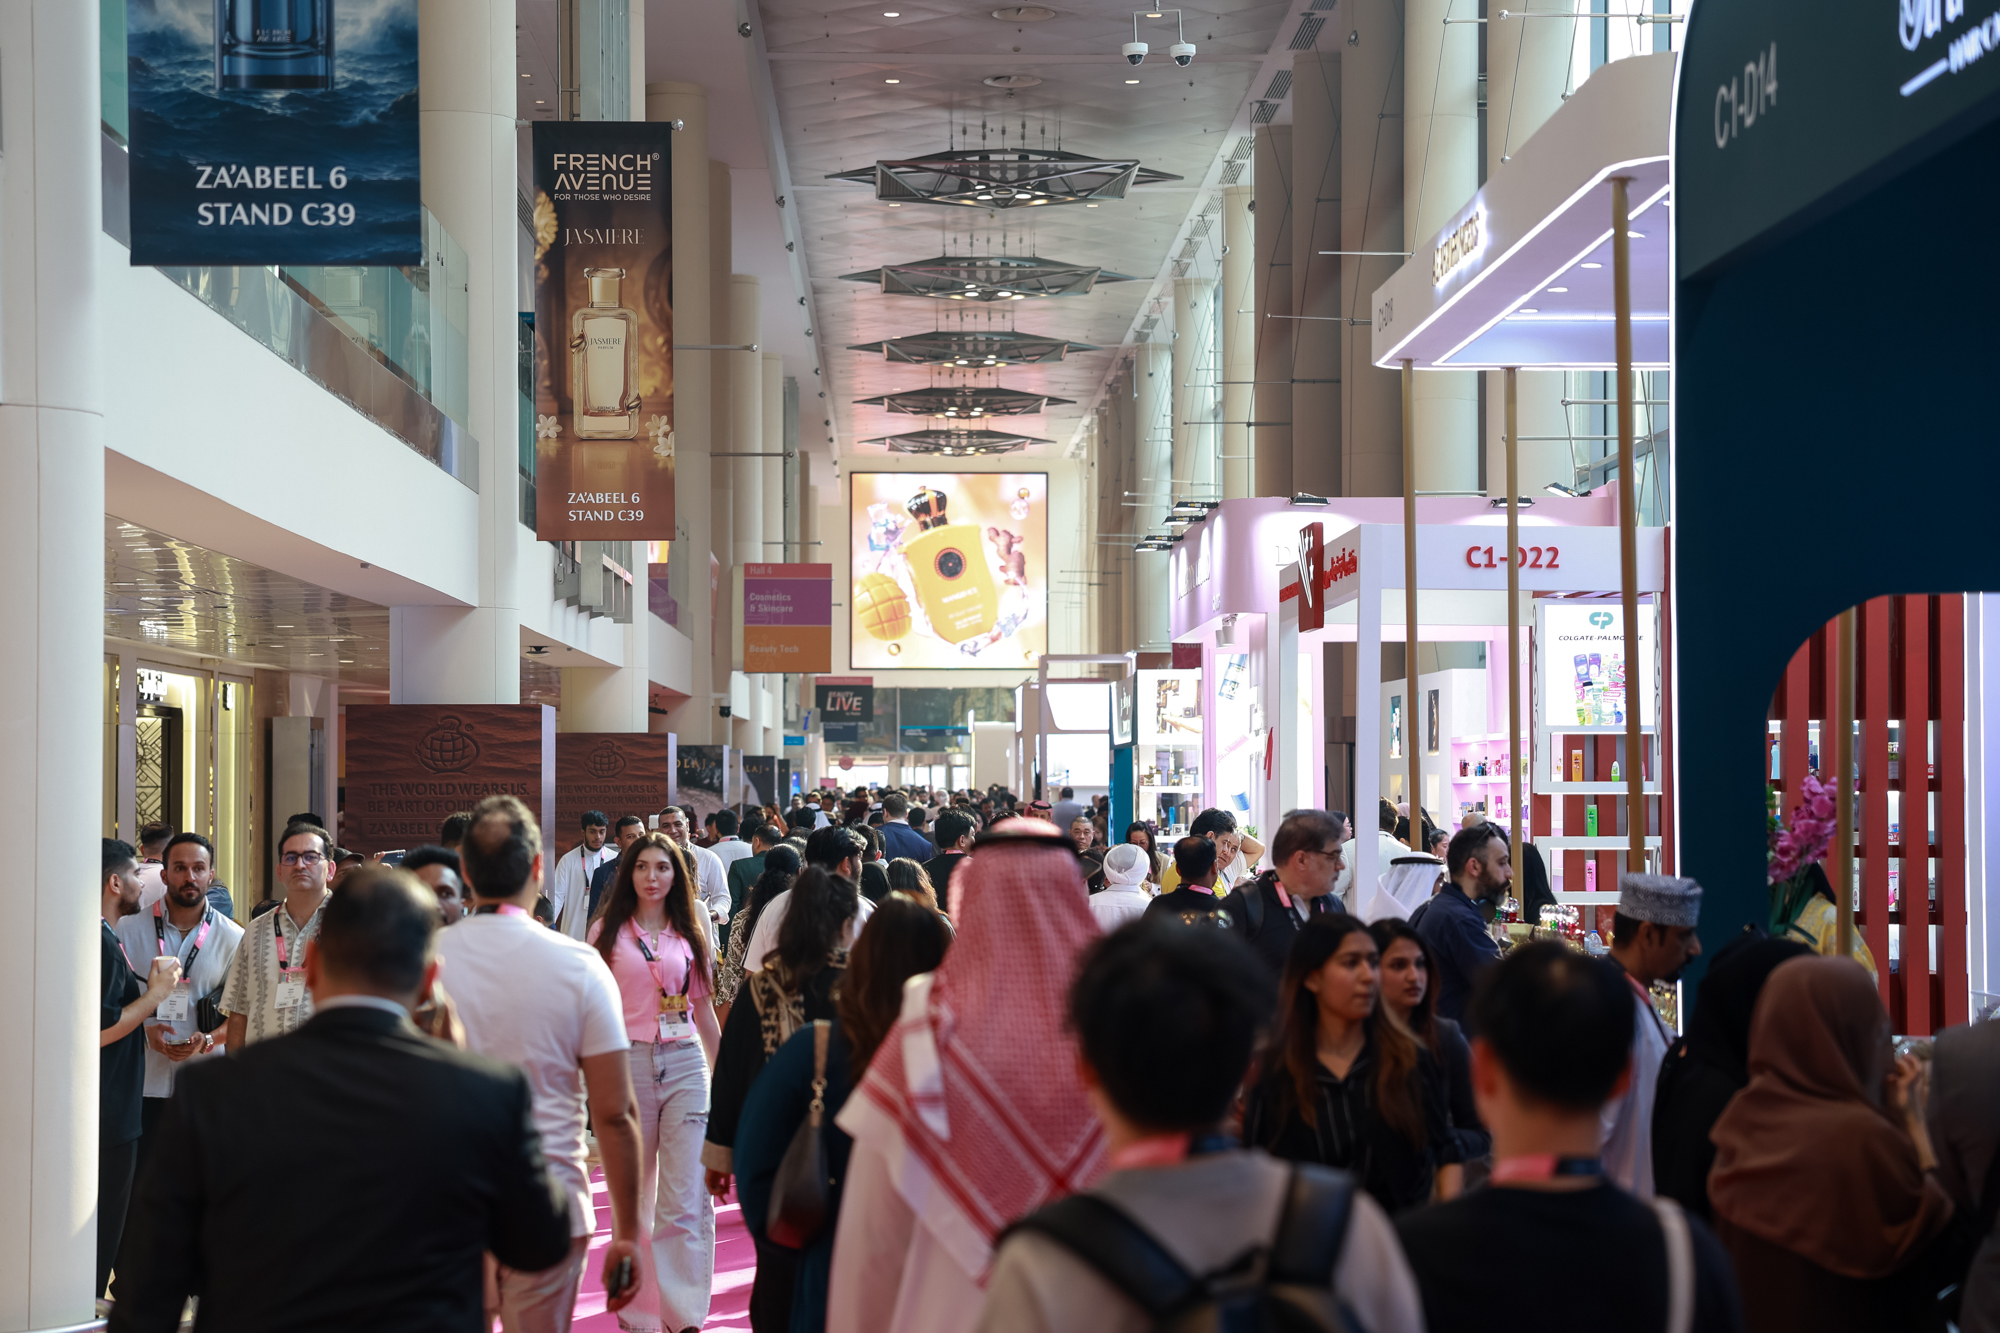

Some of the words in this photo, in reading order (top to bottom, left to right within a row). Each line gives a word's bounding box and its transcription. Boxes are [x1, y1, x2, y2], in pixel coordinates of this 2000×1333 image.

[1714, 41, 1778, 149] C1-D14
[195, 164, 323, 189] ZA’ABEEL
[329, 165, 348, 189] 6
[555, 173, 651, 190] AVENUE
[197, 203, 293, 226] STAND
[301, 203, 356, 226] C39
[564, 229, 645, 246] JASMERE
[567, 492, 628, 504] ZA’ABEEL
[631, 492, 640, 504] 6
[568, 510, 614, 521] STAND
[617, 510, 644, 521] C39
[750, 566, 765, 575] Hall
[767, 566, 772, 575] 4
[749, 593, 791, 601] Cosmetics
[758, 604, 794, 612] Skincare
[749, 645, 777, 654] Beauty
[780, 645, 799, 653] Tech
[826, 697, 863, 711] LIVE
[369, 783, 397, 796] THE
[400, 783, 456, 796] WORLD
[457, 783, 508, 796] WEARS
[510, 783, 531, 796] US.
[573, 785, 611, 794] WORLD
[611, 785, 646, 794] WEARS
[646, 785, 659, 794] US.
[566, 796, 588, 804] PART
[589, 796, 602, 804] OF
[603, 796, 623, 804] OUR
[625, 796, 661, 804] WORLD.
[368, 800, 384, 813] BE
[387, 800, 423, 813] PART
[424, 800, 442, 813] OF
[445, 800, 474, 813] OUR
[369, 823, 432, 835] ZA'ABEEL
